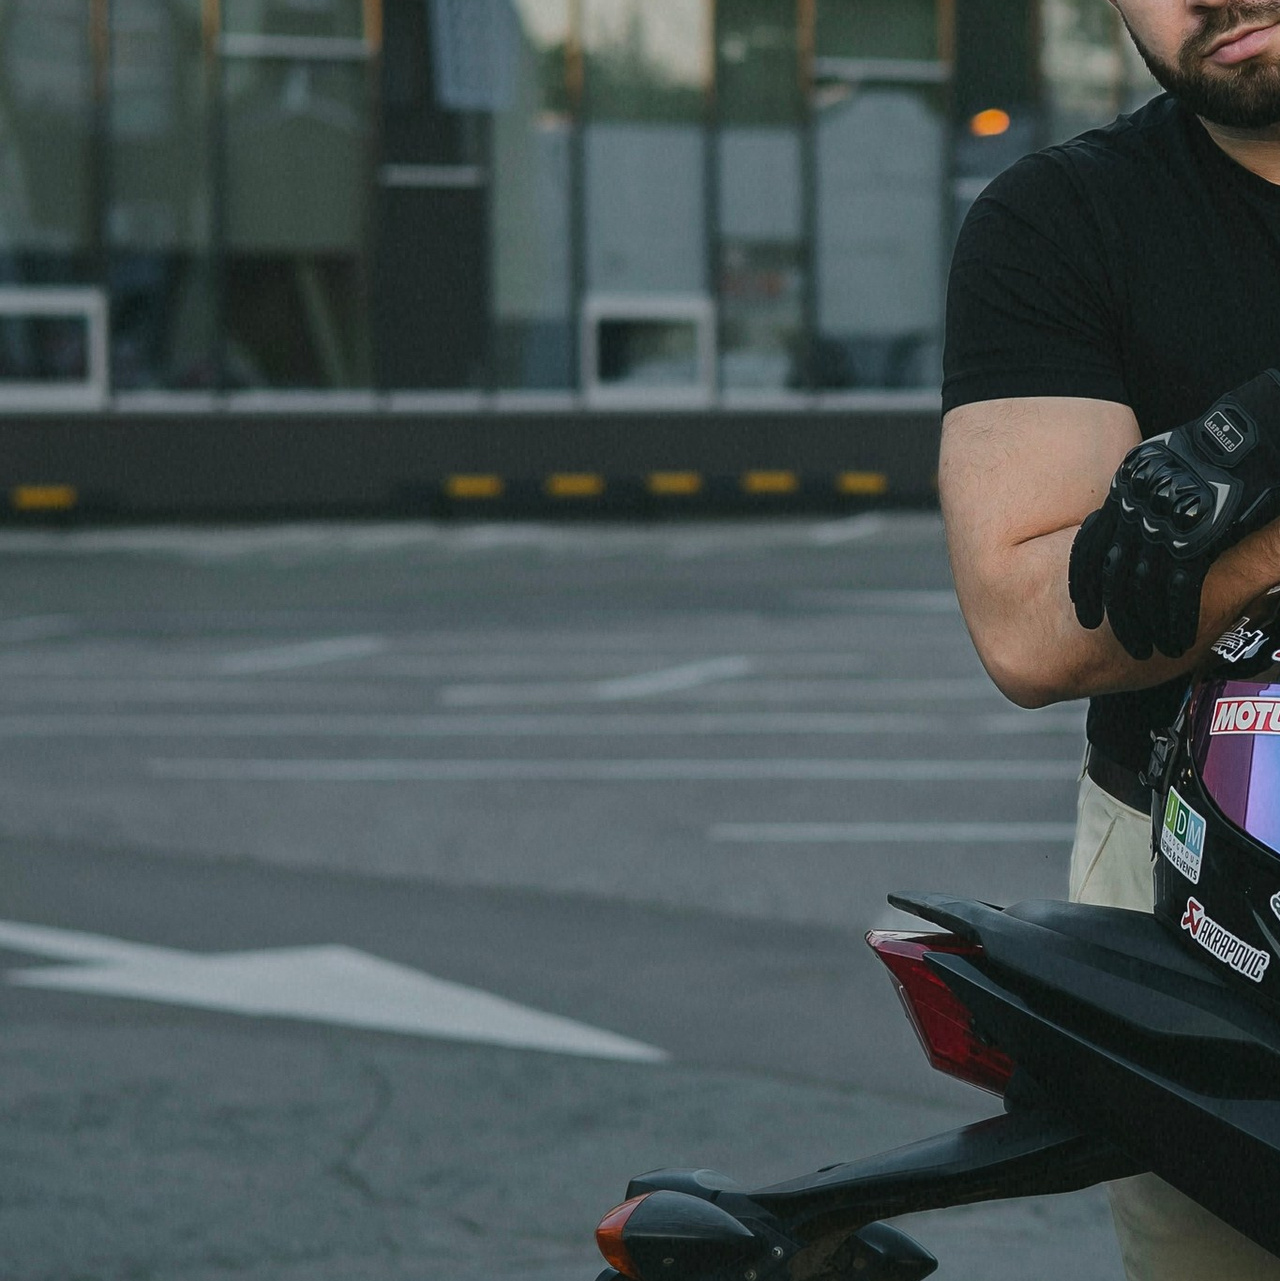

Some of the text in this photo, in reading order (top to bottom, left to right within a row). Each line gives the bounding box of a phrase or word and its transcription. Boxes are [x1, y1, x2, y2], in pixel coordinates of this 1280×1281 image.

[1207, 420, 1235, 450] ASPOLIFE
[1166, 800, 1201, 850] JDM
[1175, 855, 1198, 881] EVENTS
[1199, 920, 1267, 979] AKRAPOVIČ
